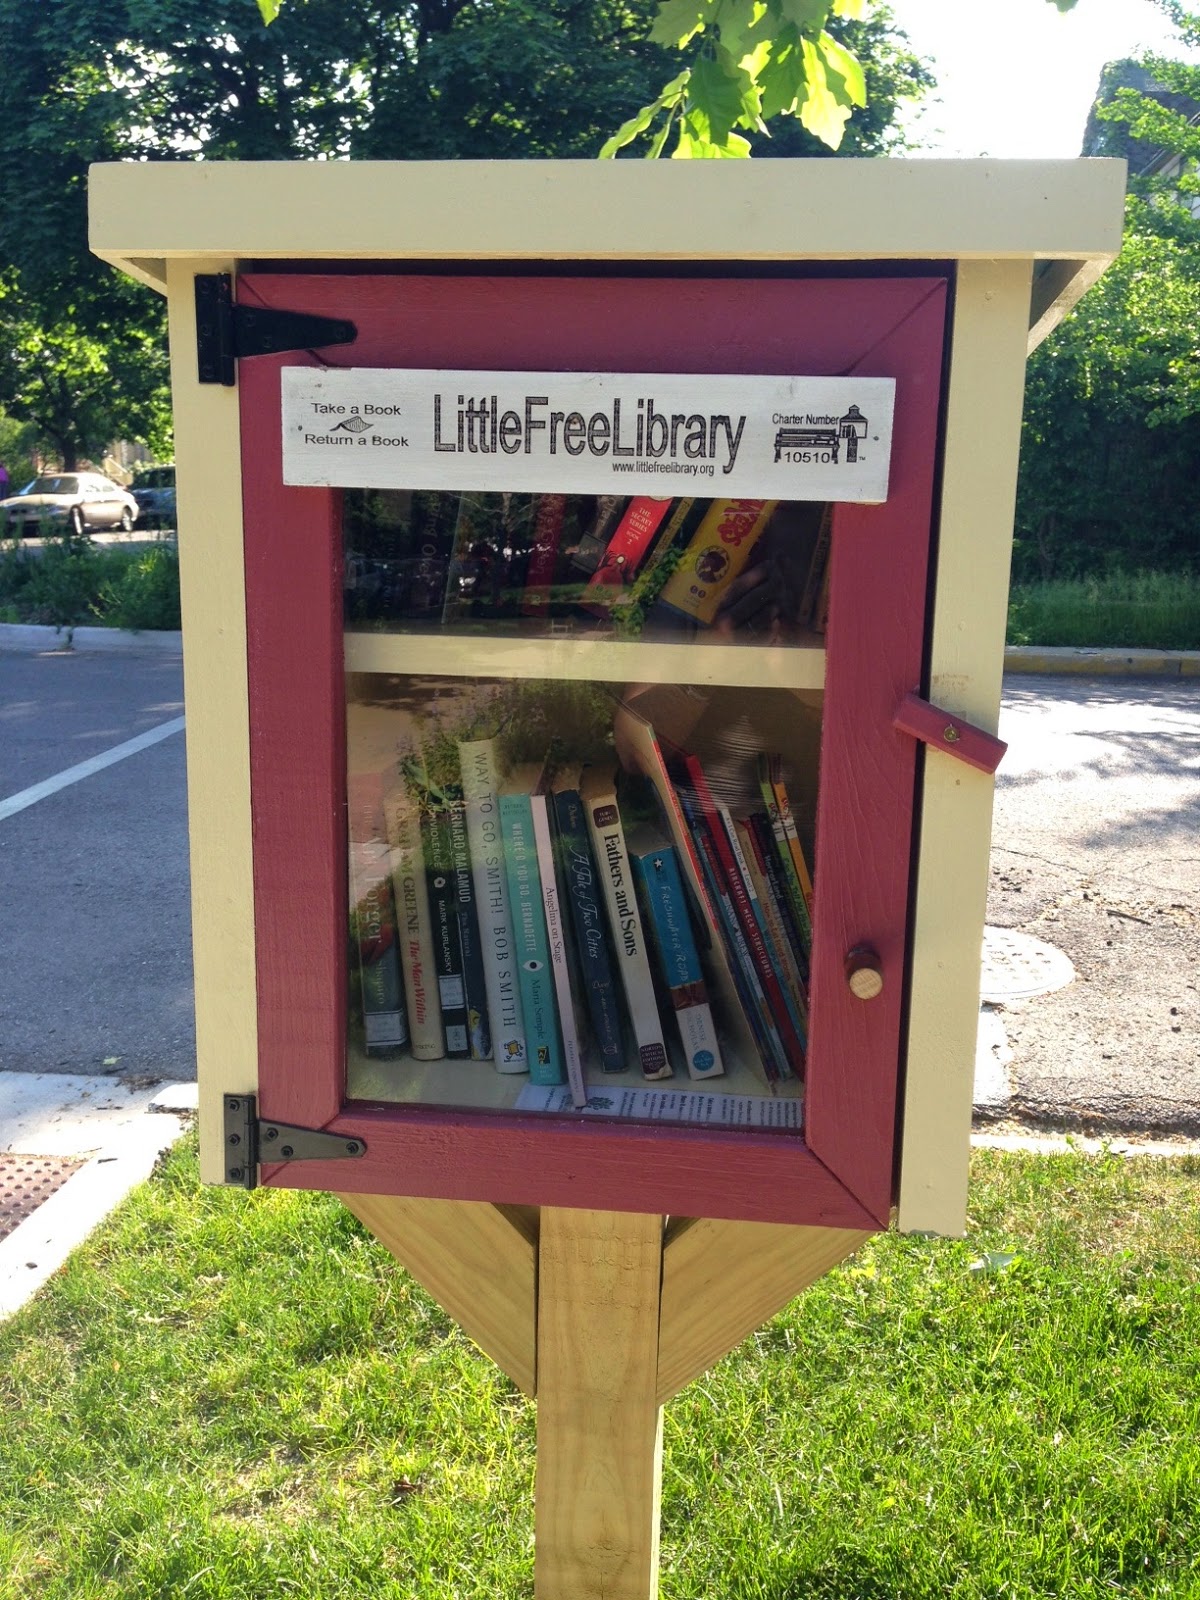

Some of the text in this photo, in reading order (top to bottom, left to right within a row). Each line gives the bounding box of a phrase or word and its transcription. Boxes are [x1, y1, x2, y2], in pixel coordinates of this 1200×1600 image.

[311, 402, 401, 415] Take a Book
[772, 413, 840, 425] Charter Number
[304, 434, 409, 447] Return a Book
[433, 394, 746, 475] LittleFreeLibrary
[612, 461, 715, 476] www.littlefreelibrary.org
[784, 451, 831, 464] 10510
[628, 518, 648, 533] SERIES
[630, 511, 653, 526] SECRET
[639, 507, 652, 518] THE
[449, 799, 472, 903] BERNARD MALAMUD
[474, 752, 504, 915] WAY TO GO, SMITH!
[571, 864, 592, 889] Tale
[572, 885, 592, 903] of
[604, 833, 637, 957] Fathers and Sons
[403, 876, 420, 934] GREENE
[438, 900, 448, 923] MARK
[577, 901, 598, 927] Two
[660, 885, 681, 949] FRESHWATER
[728, 867, 774, 979] AIRCRAFT MEGA STRUCTURES
[521, 901, 537, 952] BERNADETTE
[545, 887, 563, 964] Angelina on Stage
[585, 927, 602, 959] Cities
[441, 925, 453, 973] KURLANSKY
[409, 940, 428, 1025] The Man Within
[493, 926, 517, 1027] BOB SMITH
[531, 979, 545, 1039] Maria Semple
